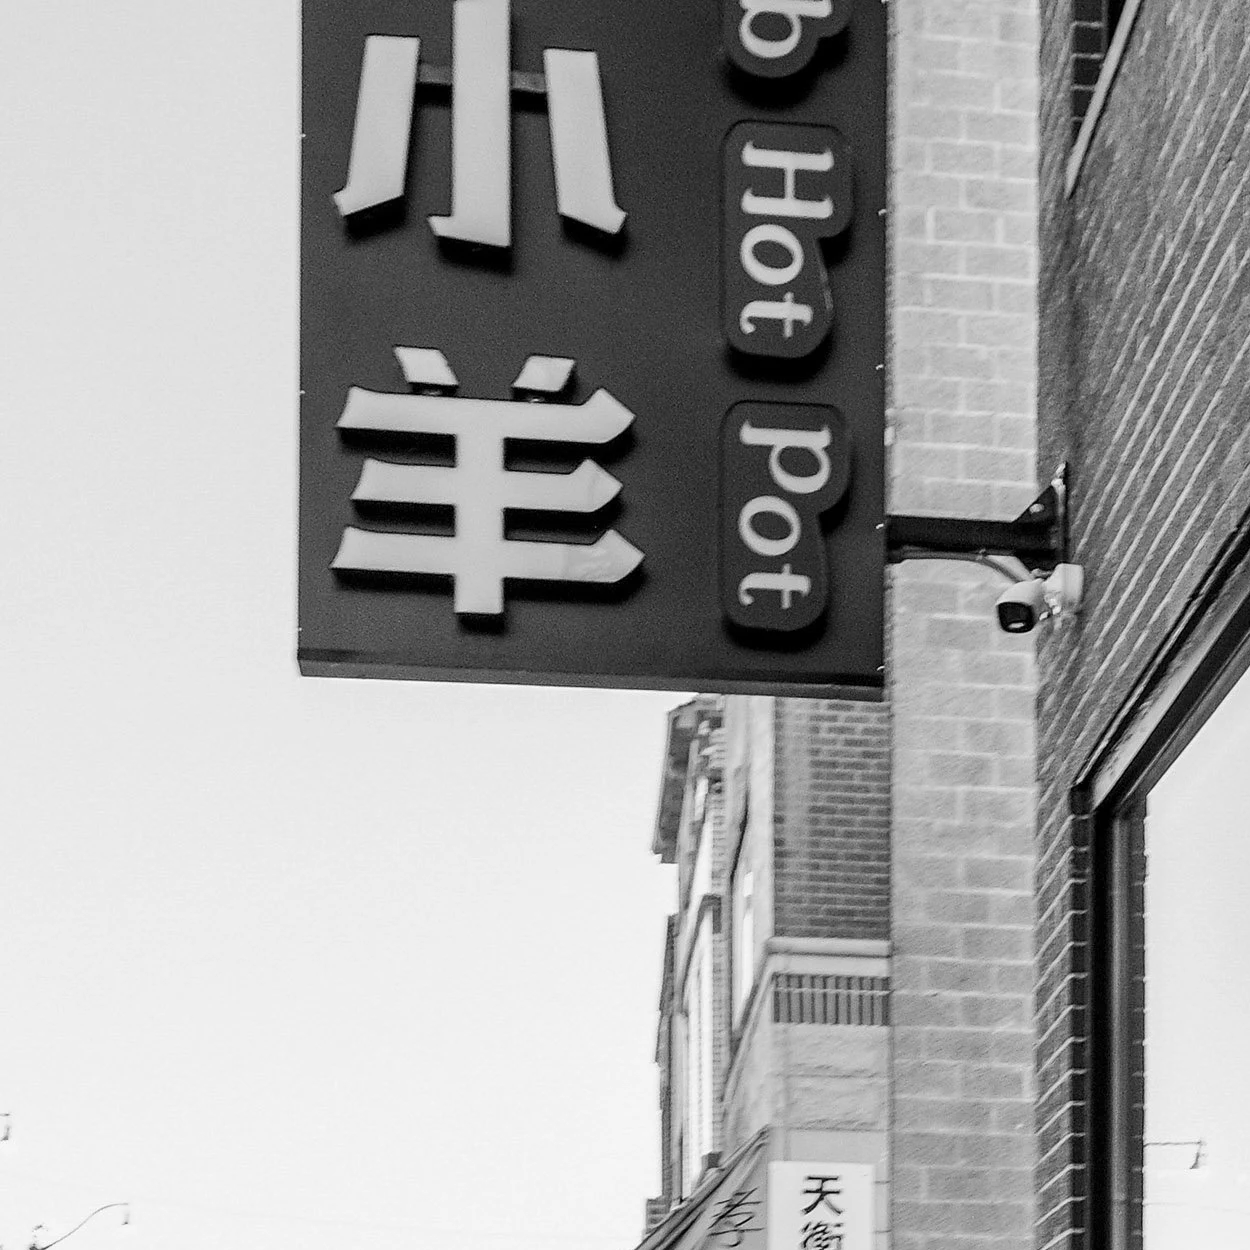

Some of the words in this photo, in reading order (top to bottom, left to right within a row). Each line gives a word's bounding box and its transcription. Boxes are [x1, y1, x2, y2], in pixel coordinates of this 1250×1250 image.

[330, 0, 645, 614] 小羊
[740, 140, 834, 338] Hot
[738, 420, 832, 609] pot
